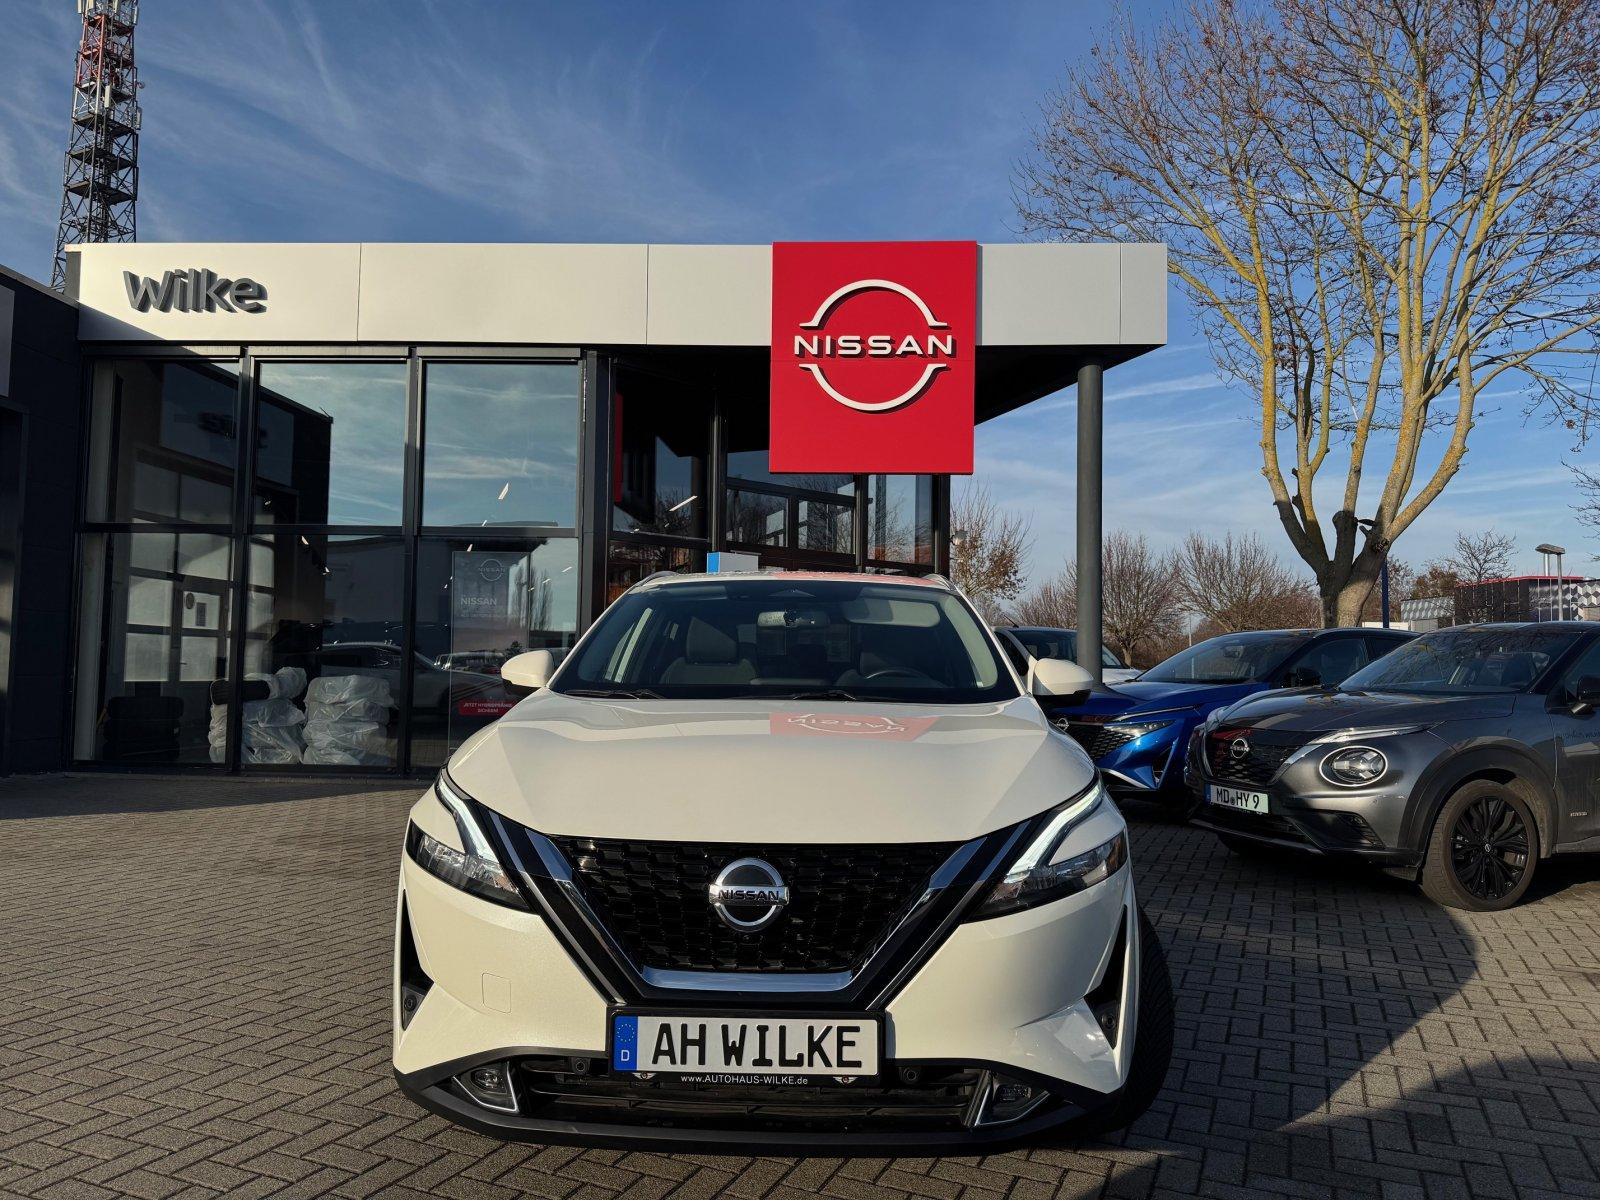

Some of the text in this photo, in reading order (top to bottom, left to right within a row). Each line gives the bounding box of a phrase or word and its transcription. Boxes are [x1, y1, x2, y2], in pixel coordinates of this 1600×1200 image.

[123, 268, 268, 313] Wilke
[794, 335, 955, 356] NISSAN
[460, 597, 497, 606] NISSAN
[1216, 788, 1260, 809] MD HY 9
[718, 889, 780, 901] NISSAN
[620, 1022, 862, 1068] D AH WILKE
[681, 1074, 808, 1085] www.AUTOHAUS-WILKE.de
